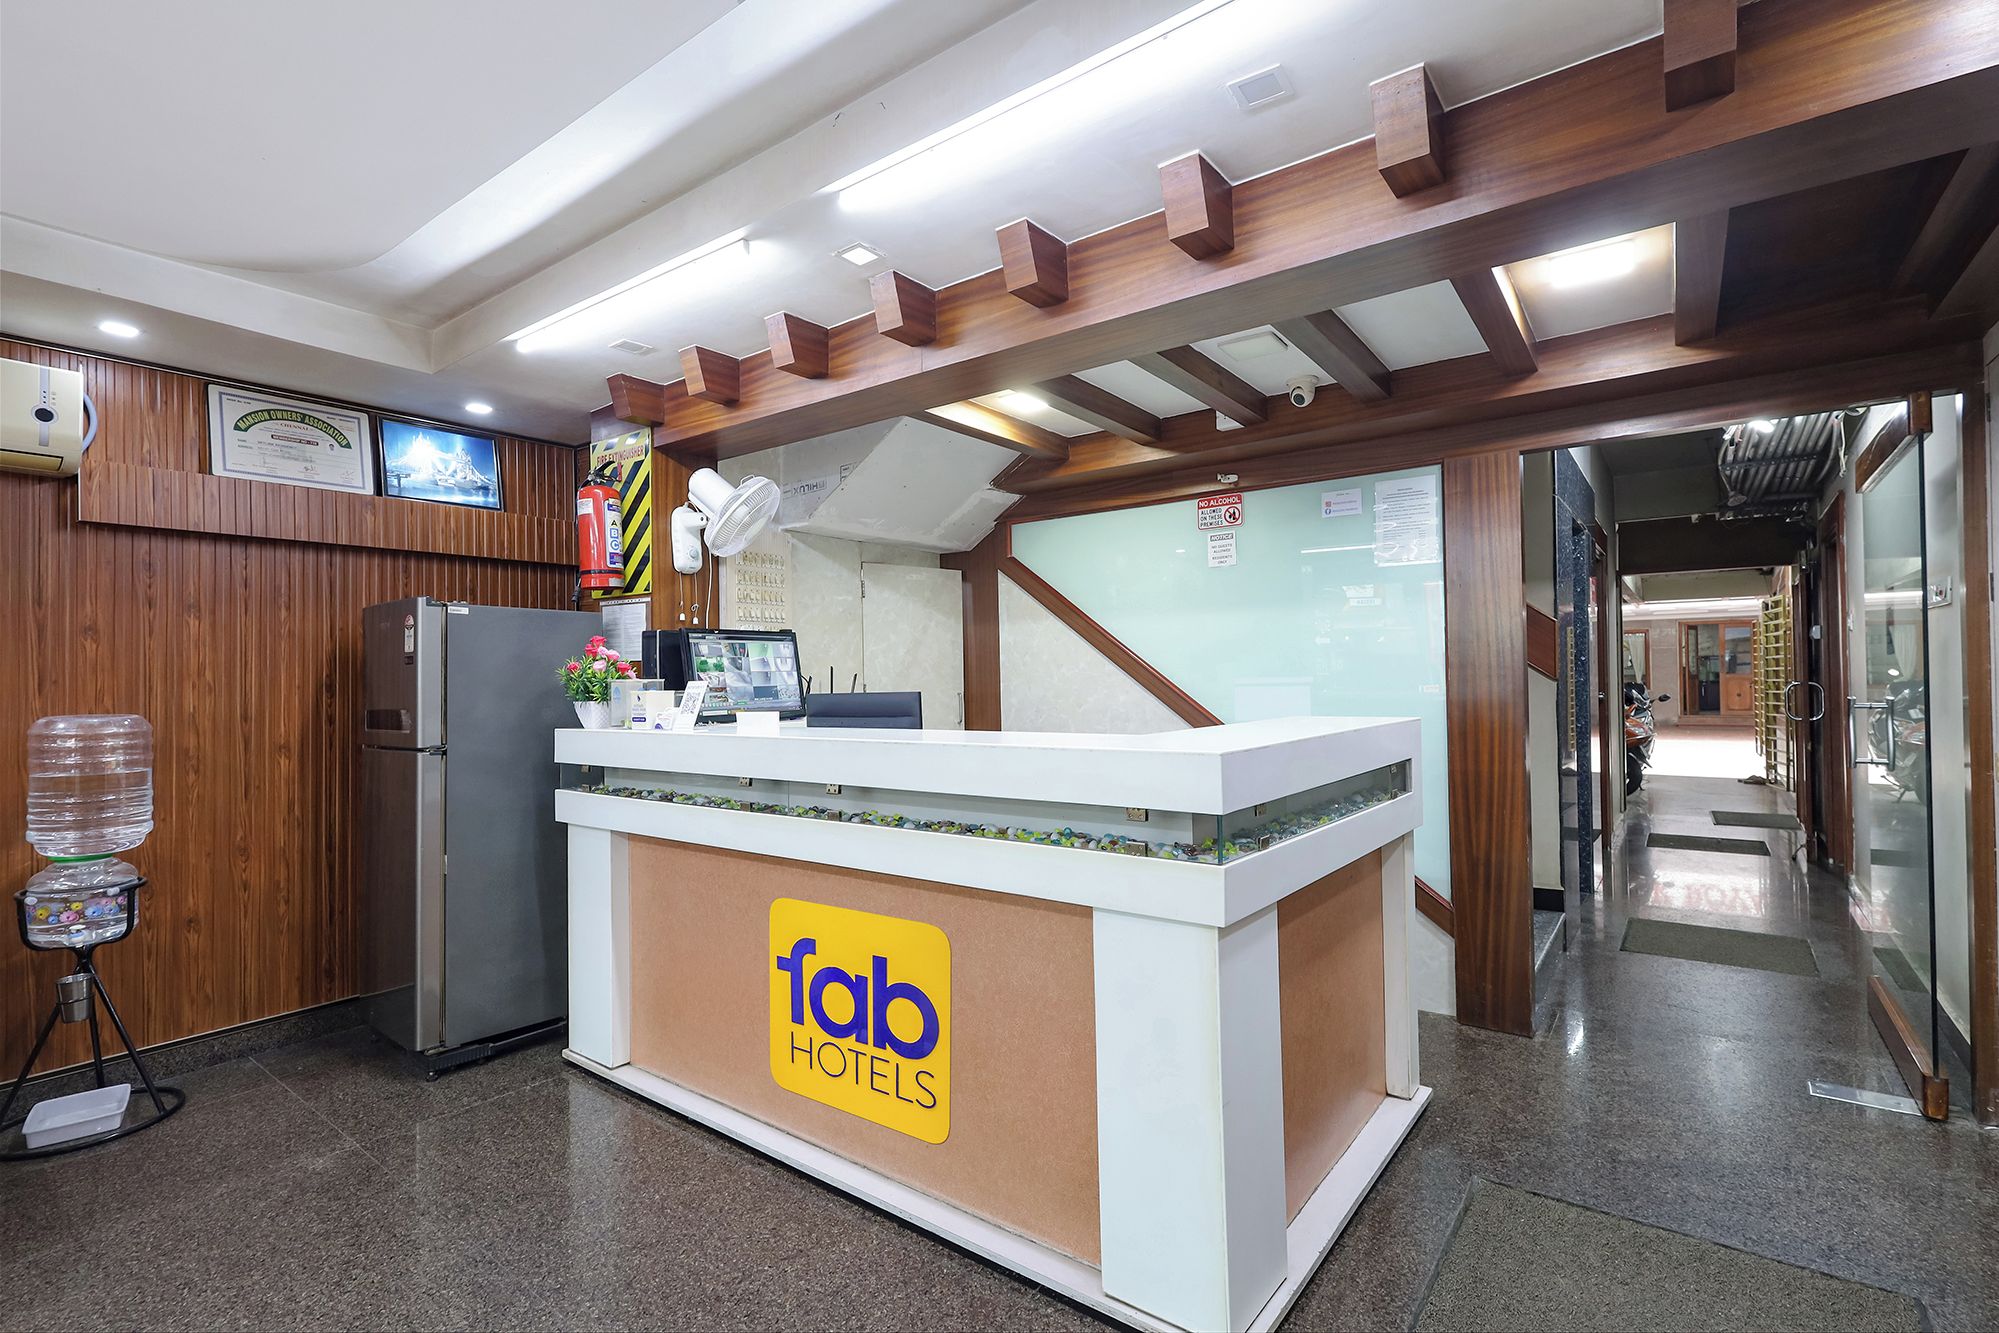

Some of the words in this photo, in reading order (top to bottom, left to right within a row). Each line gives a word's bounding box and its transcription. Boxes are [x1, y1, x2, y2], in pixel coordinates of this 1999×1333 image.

[236, 411, 270, 430] MANSION
[304, 415, 348, 446] ASSOCIATION
[280, 423, 309, 431] CHENNAI
[793, 481, 818, 495] HILUX
[1210, 497, 1240, 506] ALCOHOL
[1200, 508, 1222, 516] ALLOWED
[1210, 533, 1233, 541] NOTICE
[776, 937, 940, 1060] fab
[790, 1031, 937, 1109] HOTELS
